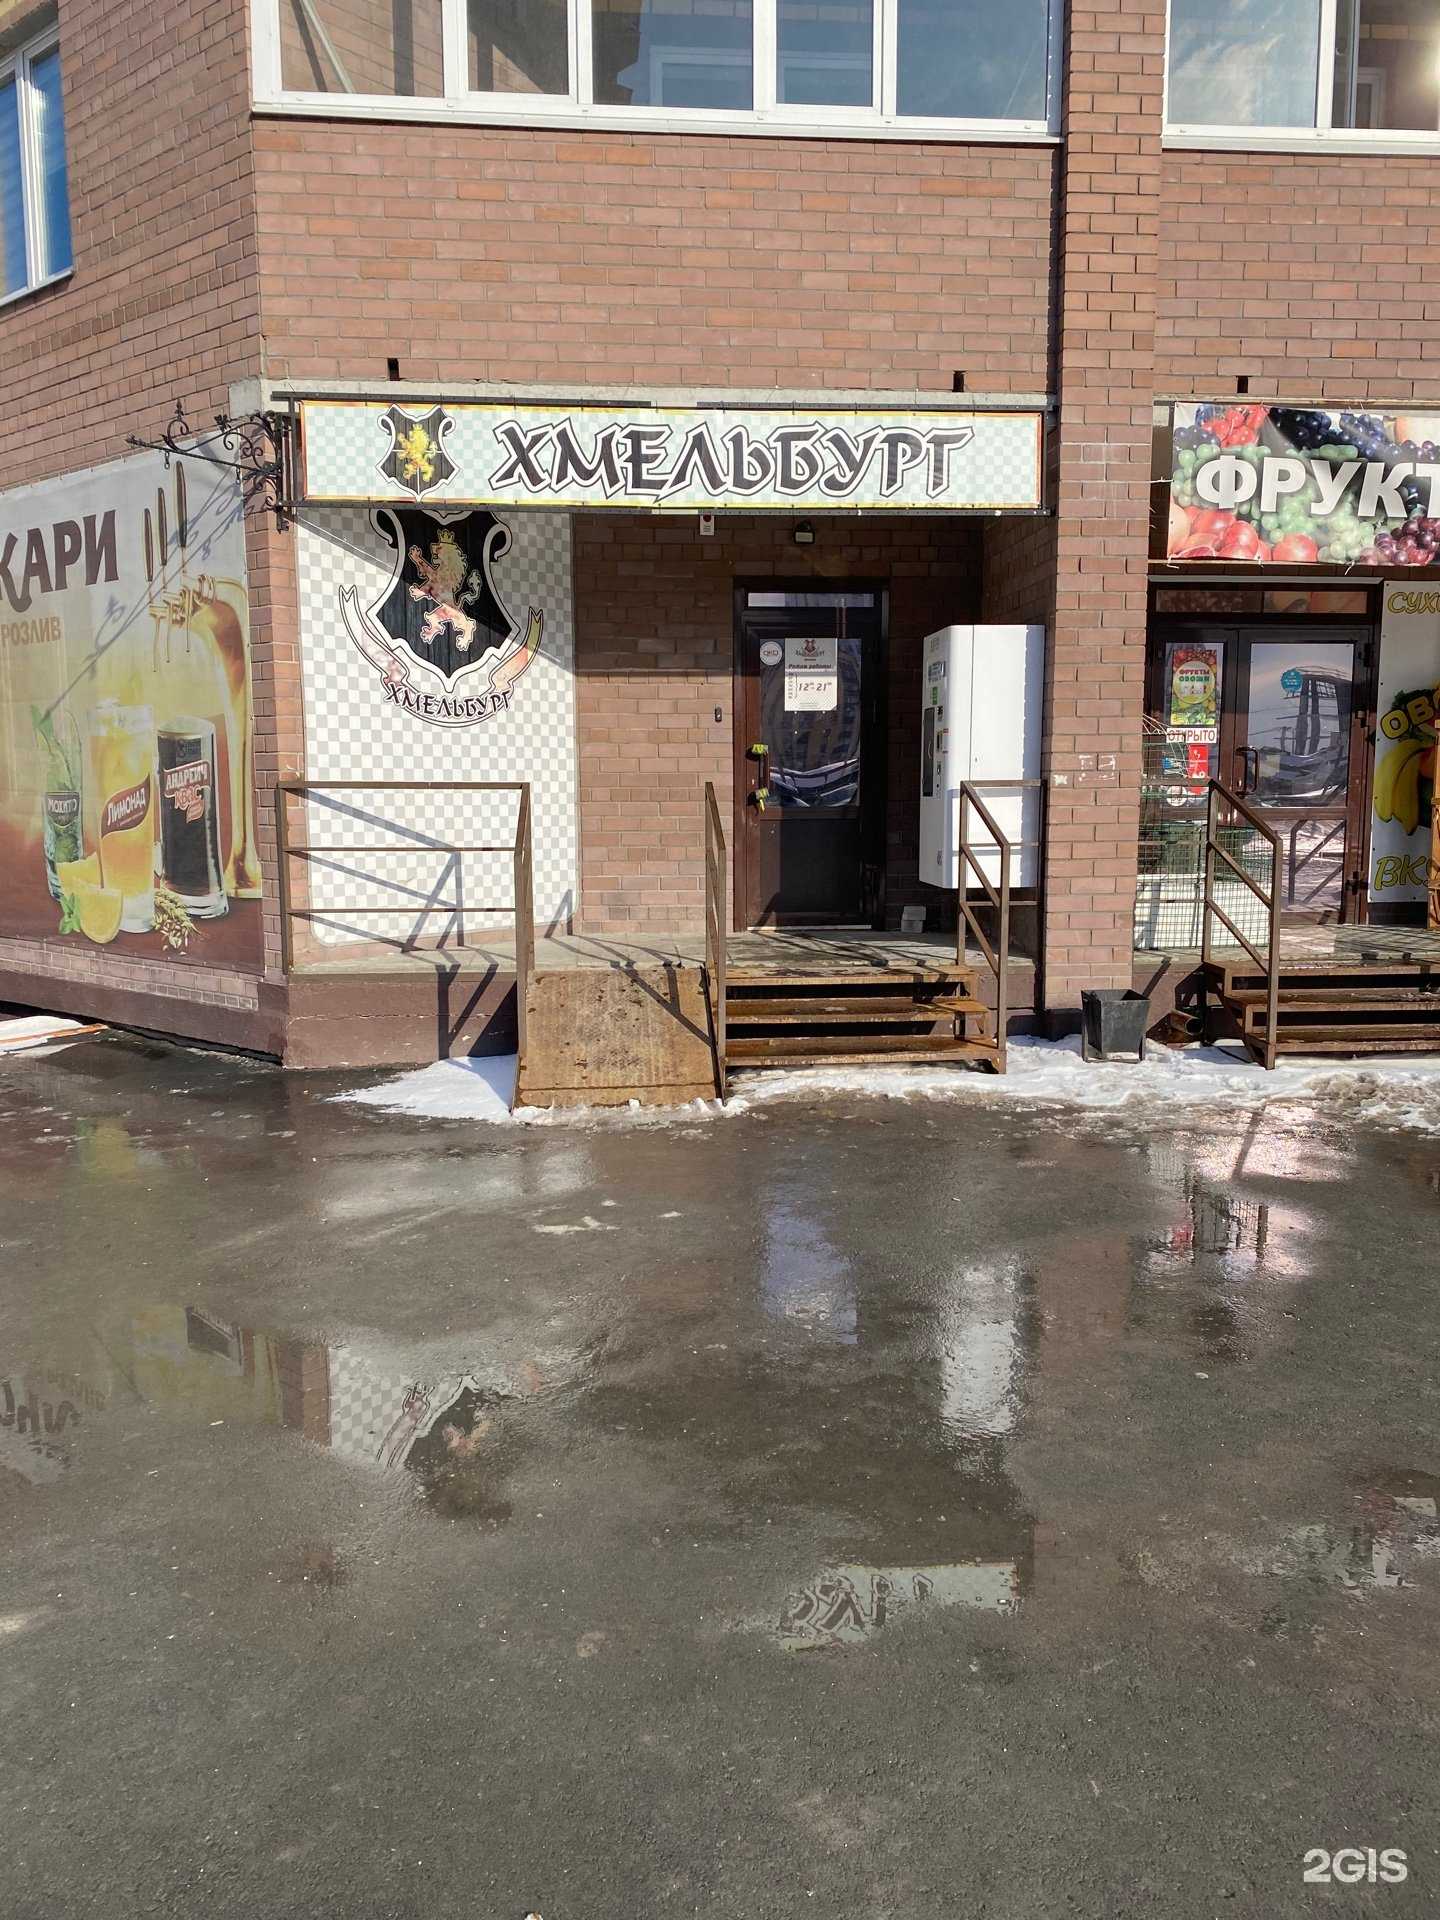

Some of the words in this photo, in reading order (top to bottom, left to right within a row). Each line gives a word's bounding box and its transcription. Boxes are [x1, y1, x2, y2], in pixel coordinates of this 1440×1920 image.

[489, 418, 974, 502] ХМЕЛЬБУРГ
[1387, 591, 1440, 614] СУХ
[386, 682, 512, 718] ХМЕЛЬБУРГ
[1380, 689, 1440, 740] ОВ
[107, 787, 146, 826] ЛИМОНАД
